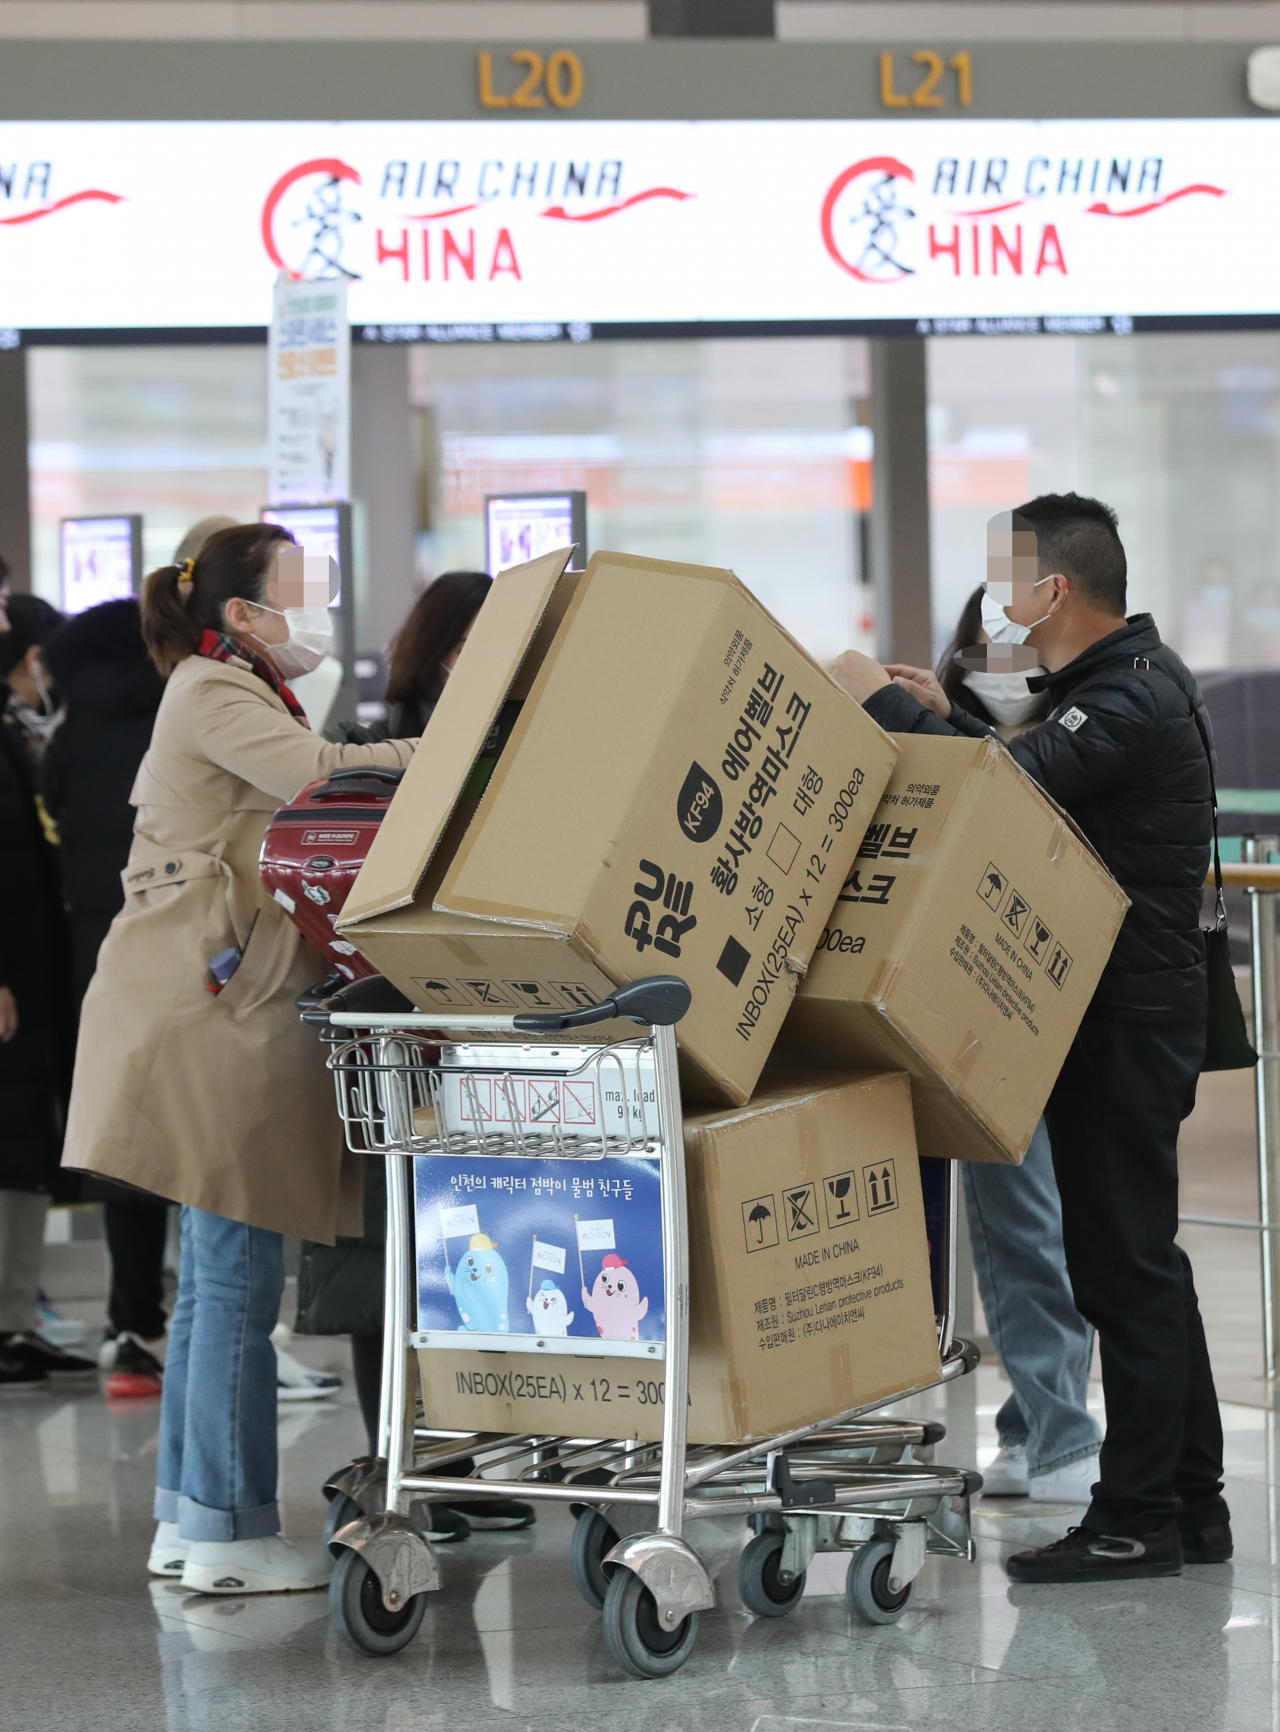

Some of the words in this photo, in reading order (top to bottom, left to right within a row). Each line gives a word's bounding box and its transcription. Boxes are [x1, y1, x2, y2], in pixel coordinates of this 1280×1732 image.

[476, 49, 585, 110] L20
[878, 49, 973, 109] L21
[0, 160, 52, 200] NA
[380, 158, 462, 199] AIR
[478, 157, 624, 200] CHINA
[932, 156, 1009, 196] AIR
[1024, 155, 1163, 198] CHINA
[723, 629, 745, 668] 의약외품
[719, 676, 737, 705] 식약처
[732, 637, 753, 677] 허가제품
[721, 661, 785, 782] 에어벨브
[684, 780, 715, 834] KF94
[709, 691, 812, 896] 황사방역마스크
[793, 764, 824, 816] 대형
[881, 793, 900, 806] 약처
[901, 795, 935, 809] 허가제품
[906, 783, 940, 796] 의약외품
[856, 823, 918, 860] 벨브
[735, 904, 805, 1042] INBOX(25EA)
[806, 853, 827, 884] 12
[828, 767, 866, 833] 300ea
[745, 876, 774, 932] 소형
[837, 870, 897, 905] 스크
[815, 927, 866, 954] 00ea
[994, 932, 1012, 956] MADE
[1010, 950, 1018, 963] IN
[1016, 957, 1033, 982] CHINA
[450, 1174, 487, 1192] 인천의
[490, 1176, 527, 1195] 캐릭터
[530, 1176, 567, 1196] 점박이
[570, 1177, 595, 1199] 물범
[598, 1178, 634, 1201] 친구들
[582, 1230, 611, 1240] INCHEON
[794, 1250, 820, 1270] MADE
[822, 1247, 831, 1261] IN
[832, 1238, 860, 1258] CHINA
[753, 1296, 777, 1315] 제품명
[756, 1314, 779, 1332] 제조원
[786, 1306, 814, 1324] Suzhou
[815, 1300, 837, 1316] Letian
[838, 1288, 872, 1310] protective
[873, 1278, 904, 1298] products
[758, 1327, 795, 1350] 수입판매원
[455, 1371, 568, 1404] INBOX(25EA)
[590, 1378, 612, 1402] 12
